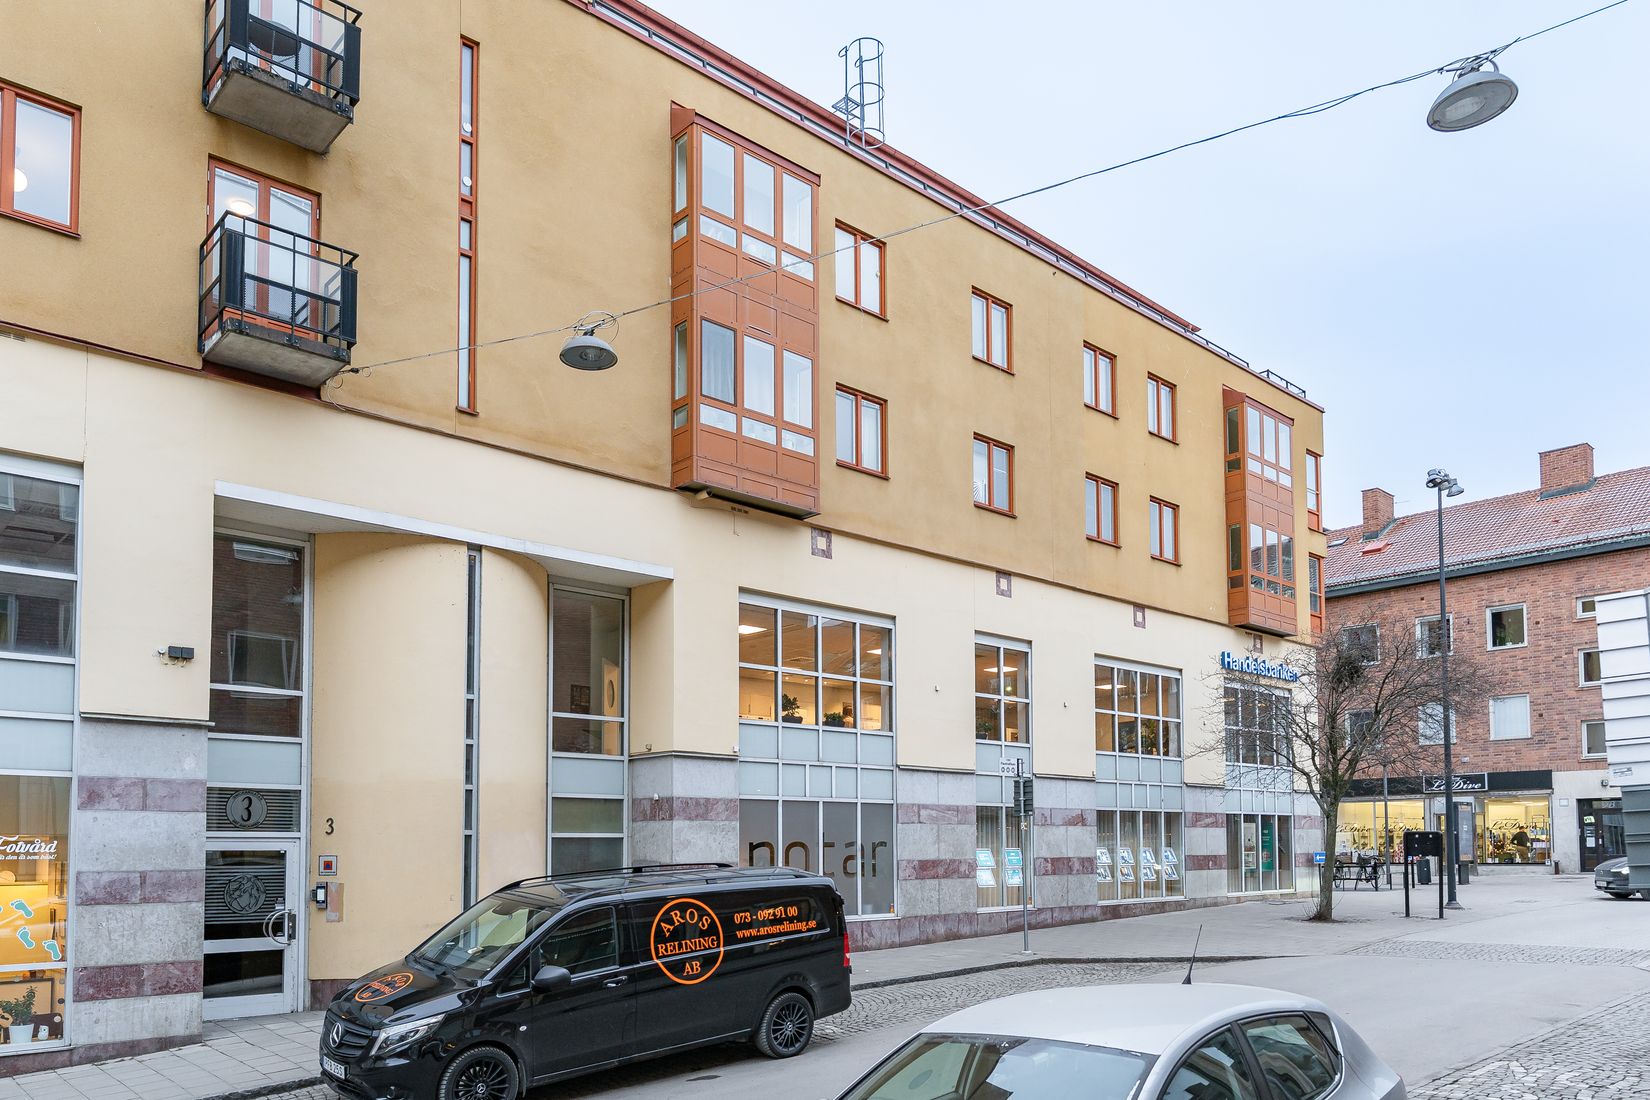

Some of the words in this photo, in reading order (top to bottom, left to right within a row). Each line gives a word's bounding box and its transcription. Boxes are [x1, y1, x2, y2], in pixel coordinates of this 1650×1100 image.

[1220, 651, 1299, 682] Handelsbanken
[241, 795, 253, 822] 3
[325, 817, 335, 835] 3
[748, 832, 888, 877] notar
[660, 908, 711, 938] AROS
[734, 912, 751, 924] 073
[757, 908, 774, 921] 092
[775, 906, 786, 919] 91
[787, 905, 798, 917] 00
[736, 920, 817, 939] www.arosrelining.se
[657, 935, 718, 957] RELINING
[683, 960, 701, 976] AB
